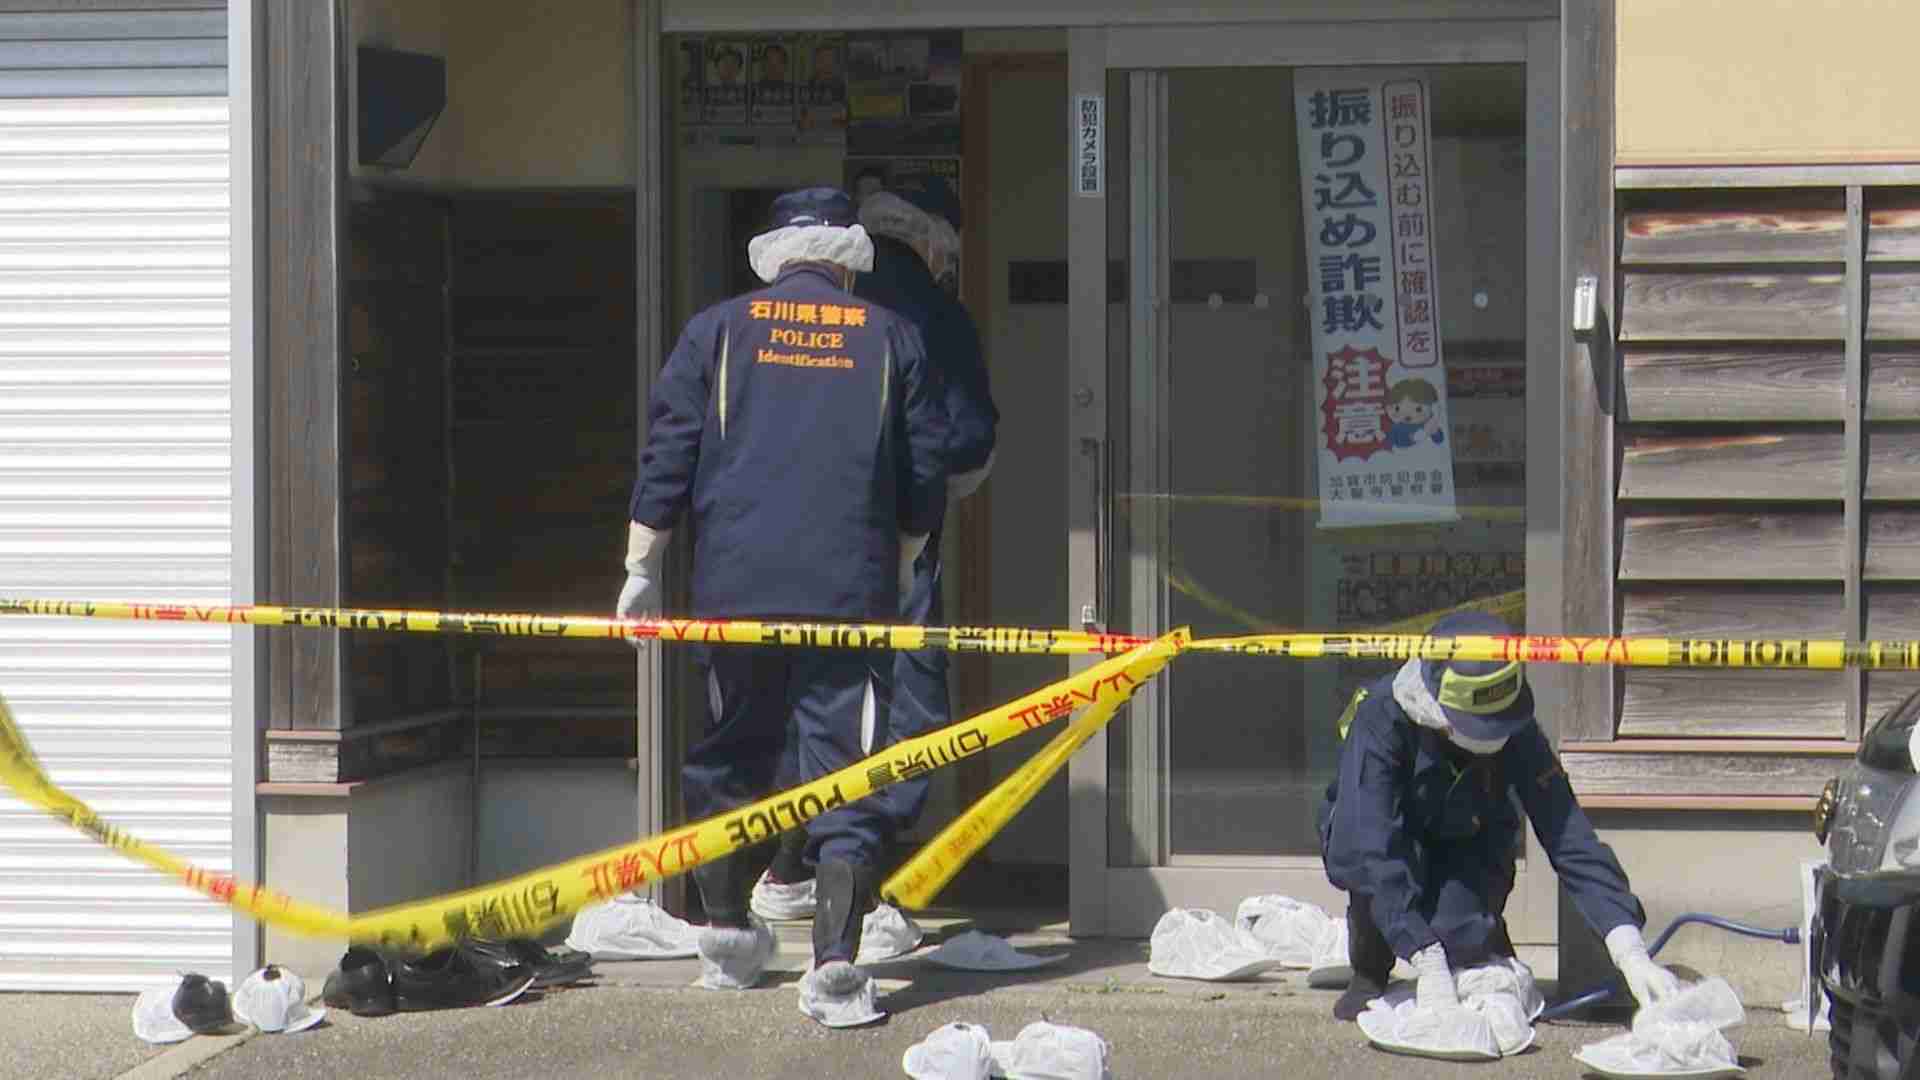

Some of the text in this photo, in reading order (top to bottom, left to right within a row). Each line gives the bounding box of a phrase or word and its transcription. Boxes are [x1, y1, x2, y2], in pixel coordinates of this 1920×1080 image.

[1308, 88, 1384, 334] 振り込め詐欺
[1390, 94, 1431, 354] 振り込む前に確認を
[749, 300, 867, 327] 石川県警察
[769, 328, 844, 349] POLICE
[757, 349, 855, 369] Identification
[1330, 354, 1386, 445] 注意
[1668, 638, 1808, 668] POLICE
[724, 783, 846, 844] POLICE
[581, 832, 702, 900] 立入禁止
